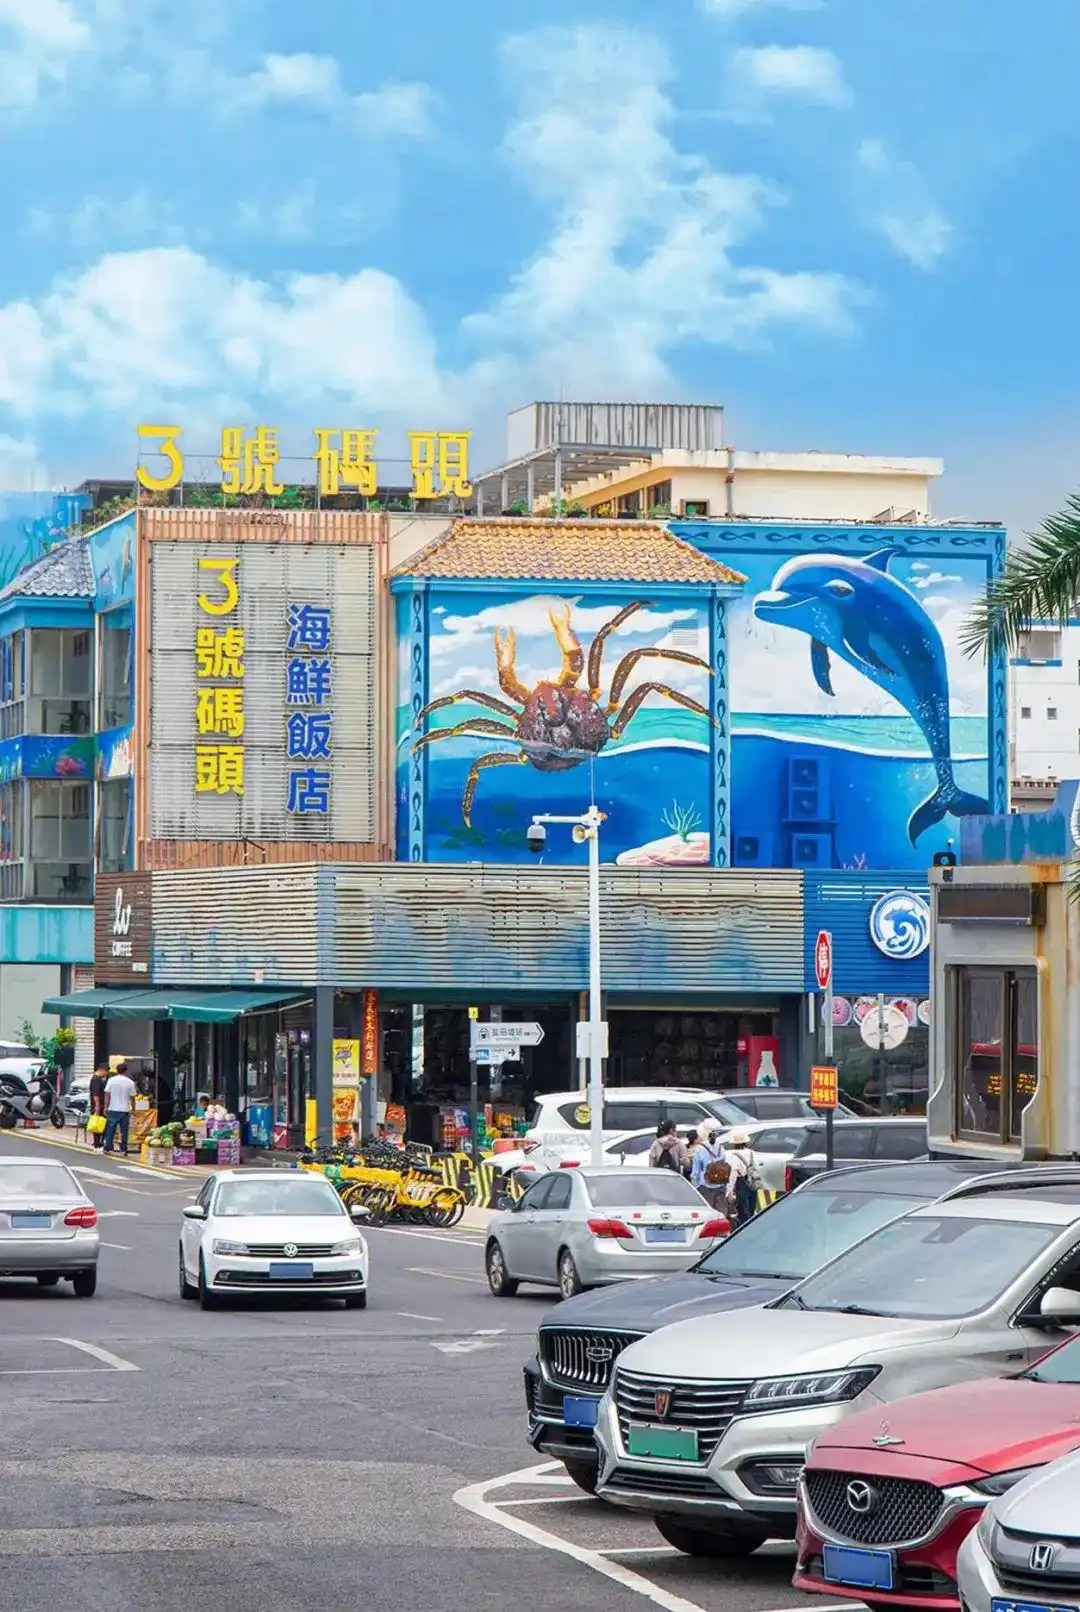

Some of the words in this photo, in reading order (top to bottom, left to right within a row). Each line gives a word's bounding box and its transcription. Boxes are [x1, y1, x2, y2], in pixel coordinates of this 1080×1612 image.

[136, 425, 472, 499] 3號碼頭
[195, 558, 245, 796] 3號碼頭
[286, 603, 332, 815] 海鮮飯店
